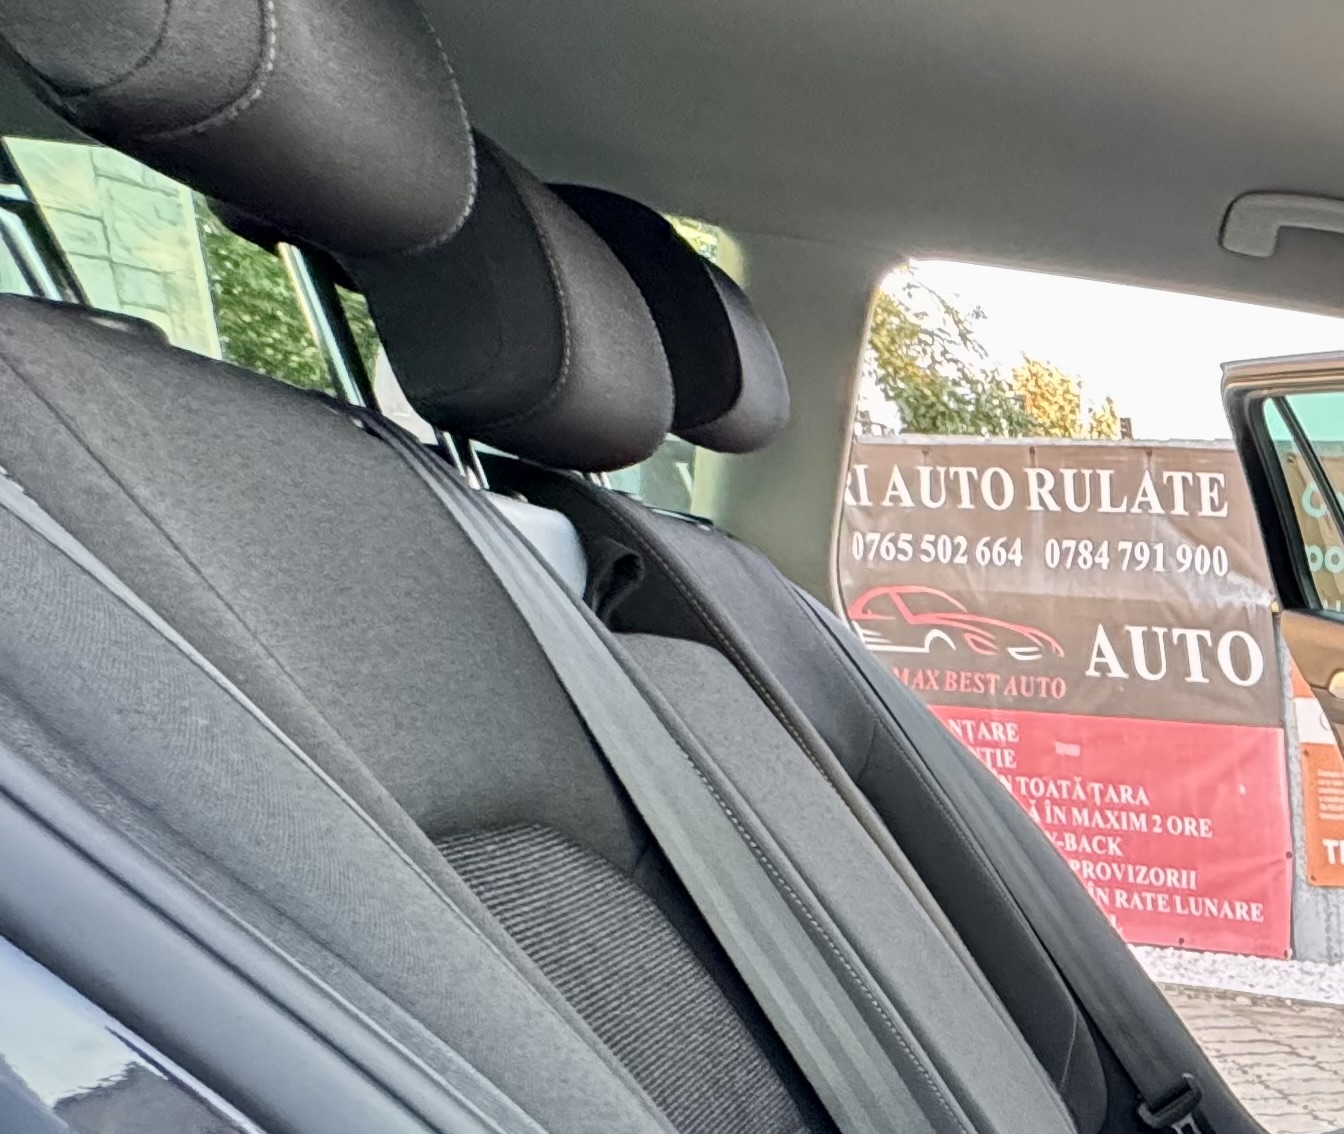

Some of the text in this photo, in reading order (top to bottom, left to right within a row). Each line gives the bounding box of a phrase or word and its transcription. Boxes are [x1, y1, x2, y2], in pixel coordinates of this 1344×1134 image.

[881, 464, 1015, 511] AUTO
[1023, 467, 1229, 518] RULATE
[852, 531, 1229, 577] 0765 502 664 0784 791 900
[1085, 623, 1264, 687] AUTO
[944, 670, 1000, 696] BEST
[1003, 675, 1067, 699] AUTO
[1044, 799, 1068, 825] ÎN
[1071, 806, 1148, 833] MAXIM
[1152, 815, 1164, 834] 2
[1167, 815, 1213, 839] ORE
[1069, 858, 1198, 890] PROVIZORII
[1114, 888, 1171, 914] RATE
[1173, 894, 1265, 923] LUNARE
